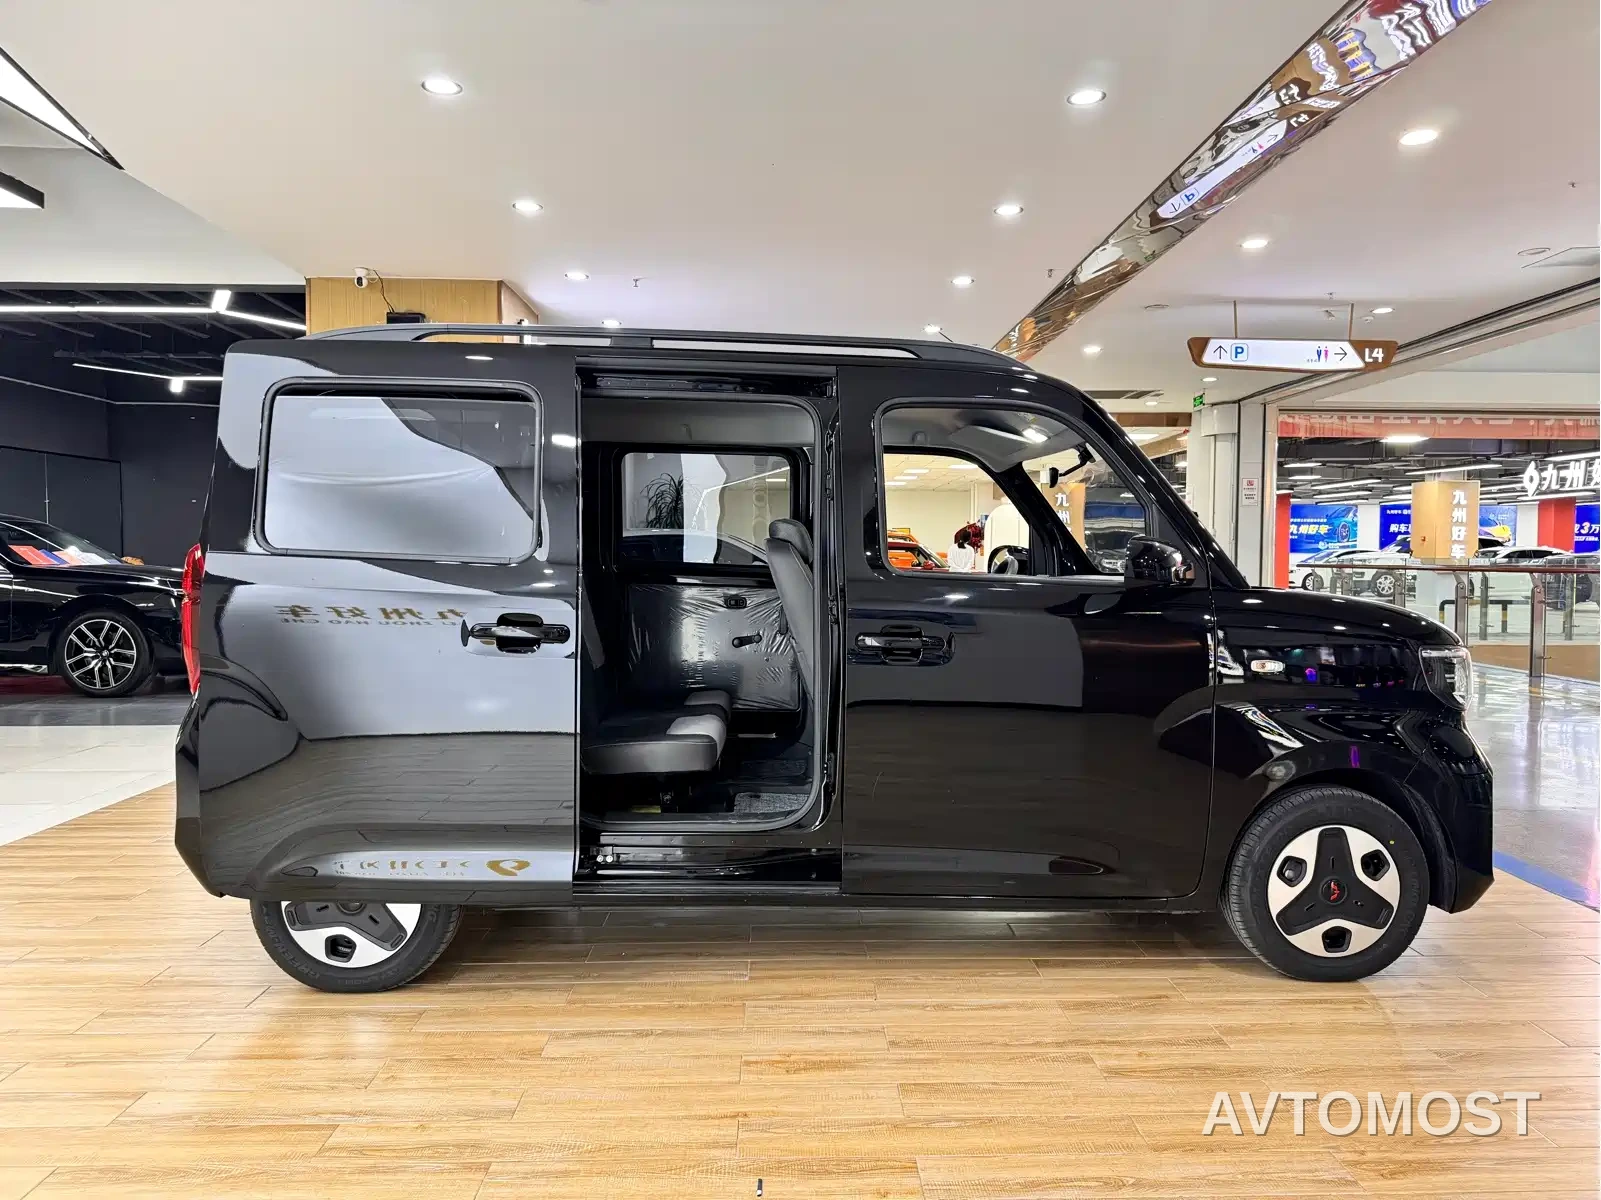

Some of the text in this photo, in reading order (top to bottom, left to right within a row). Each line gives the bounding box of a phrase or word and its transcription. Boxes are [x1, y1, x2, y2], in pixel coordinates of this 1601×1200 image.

[1234, 346, 1245, 358] P
[1364, 348, 1384, 363] L4
[1055, 492, 1071, 533] 九州
[1290, 524, 1329, 535] 九州好车
[1389, 523, 1412, 533] 购车
[1451, 489, 1467, 559] 九州好车
